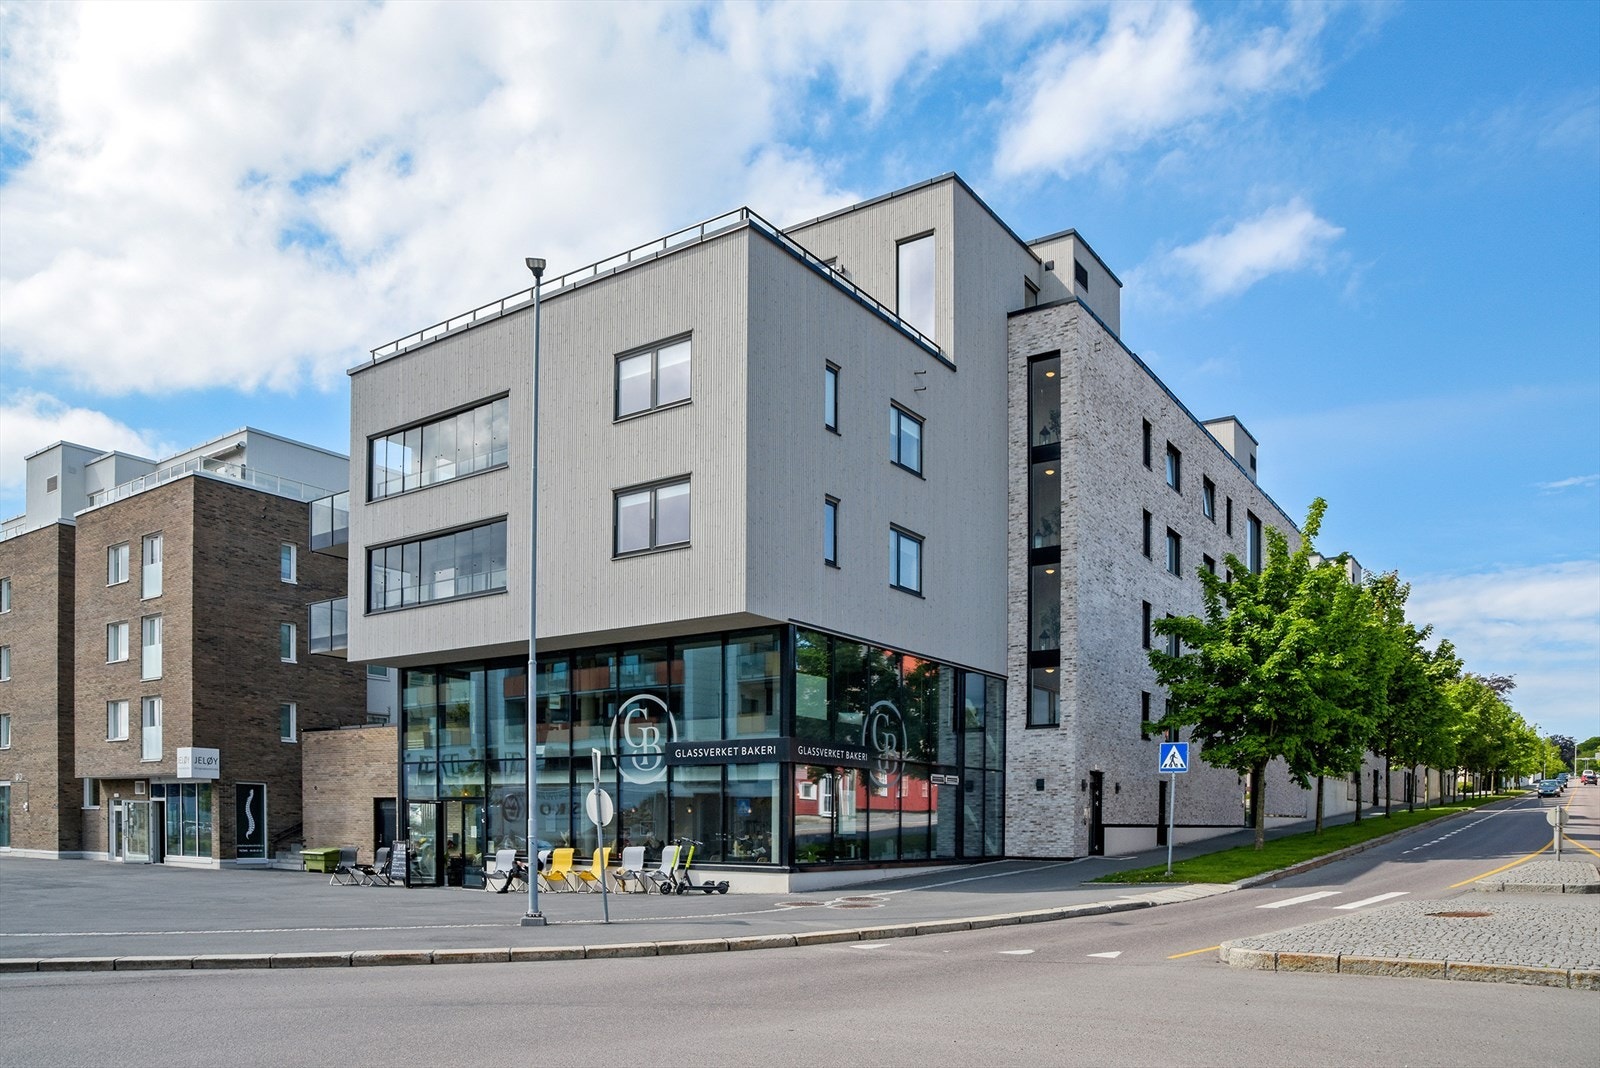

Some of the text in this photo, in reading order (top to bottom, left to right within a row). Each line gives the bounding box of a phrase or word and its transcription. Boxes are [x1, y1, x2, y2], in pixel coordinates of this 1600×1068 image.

[675, 745, 776, 758] GLASSVERKET BAKERI
[797, 745, 868, 761] GLASSVERKET BAKERI
[194, 756, 218, 765] JELØY
